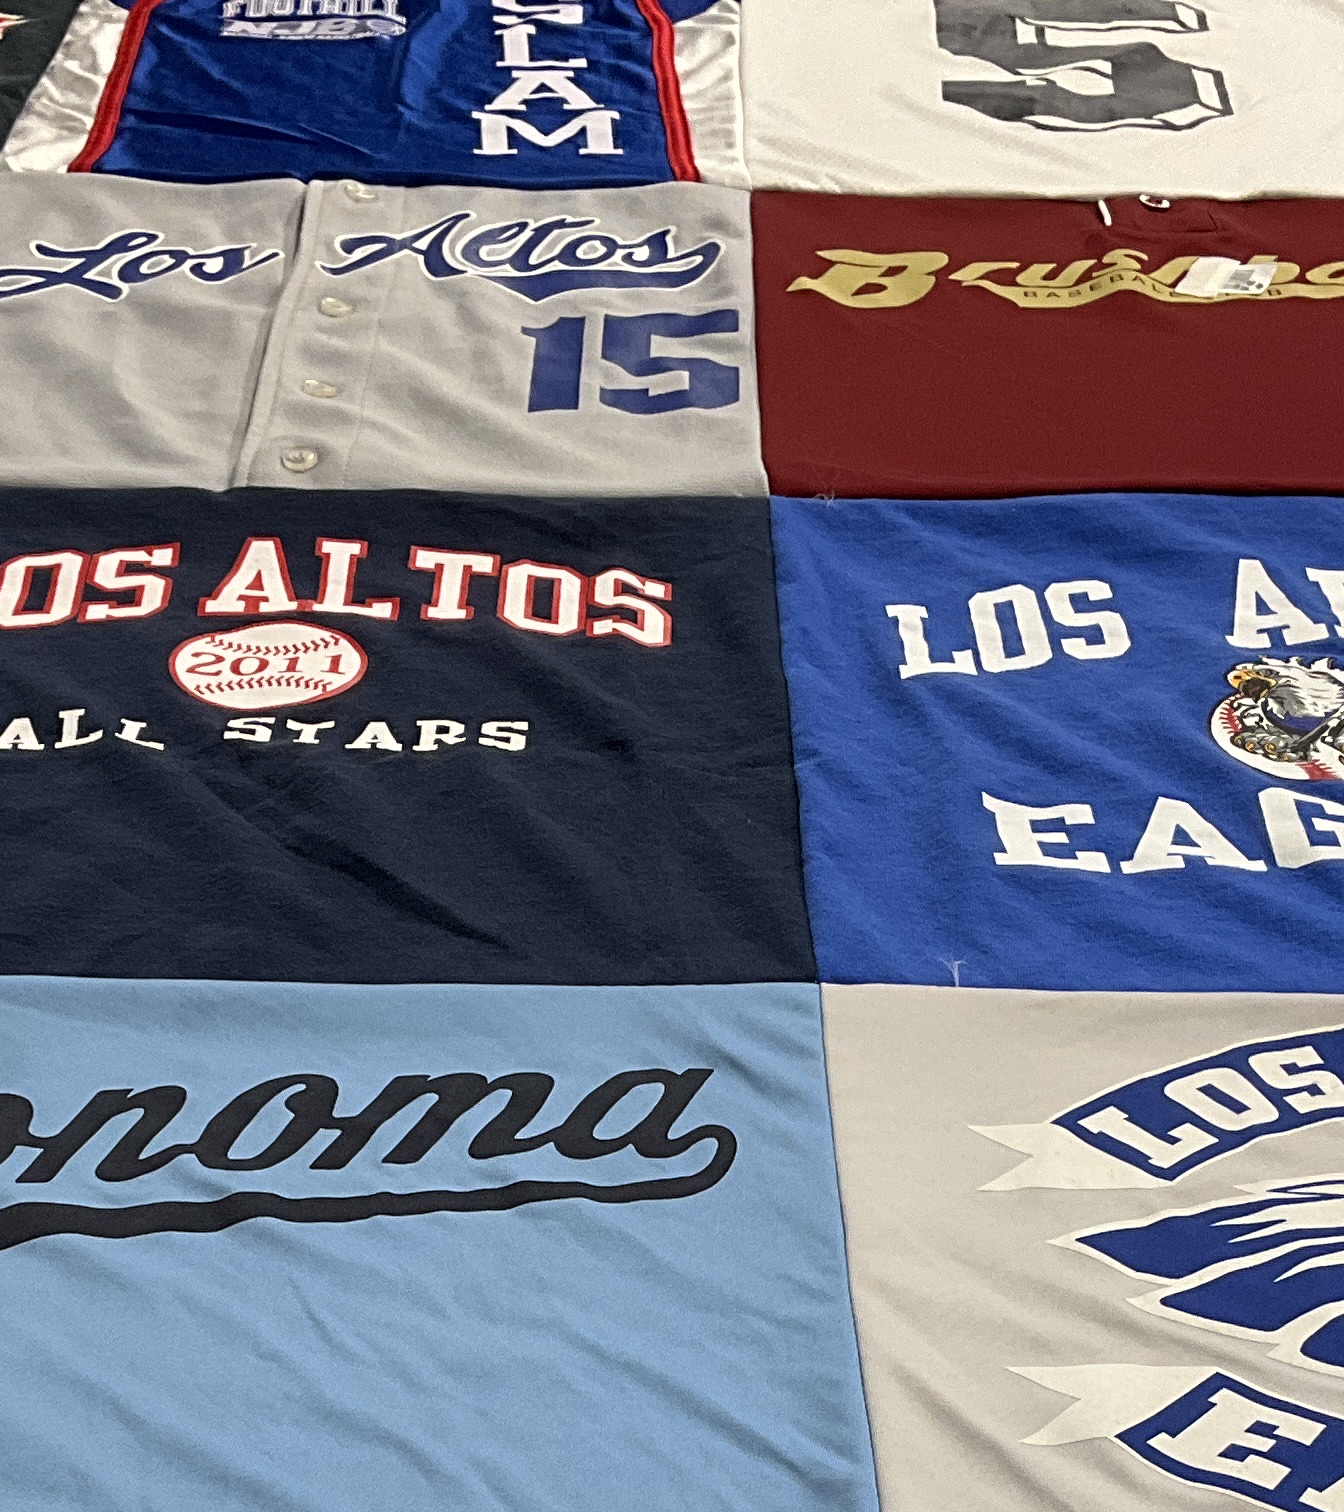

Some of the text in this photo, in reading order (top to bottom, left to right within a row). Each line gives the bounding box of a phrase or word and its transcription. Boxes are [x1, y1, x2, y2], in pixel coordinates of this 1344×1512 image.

[316, 210, 727, 304] Altos
[520, 309, 742, 416] 15
[196, 536, 675, 648] ALTOS
[885, 579, 1133, 680] LOS
[185, 649, 350, 680] 2011
[221, 716, 531, 753] STARS
